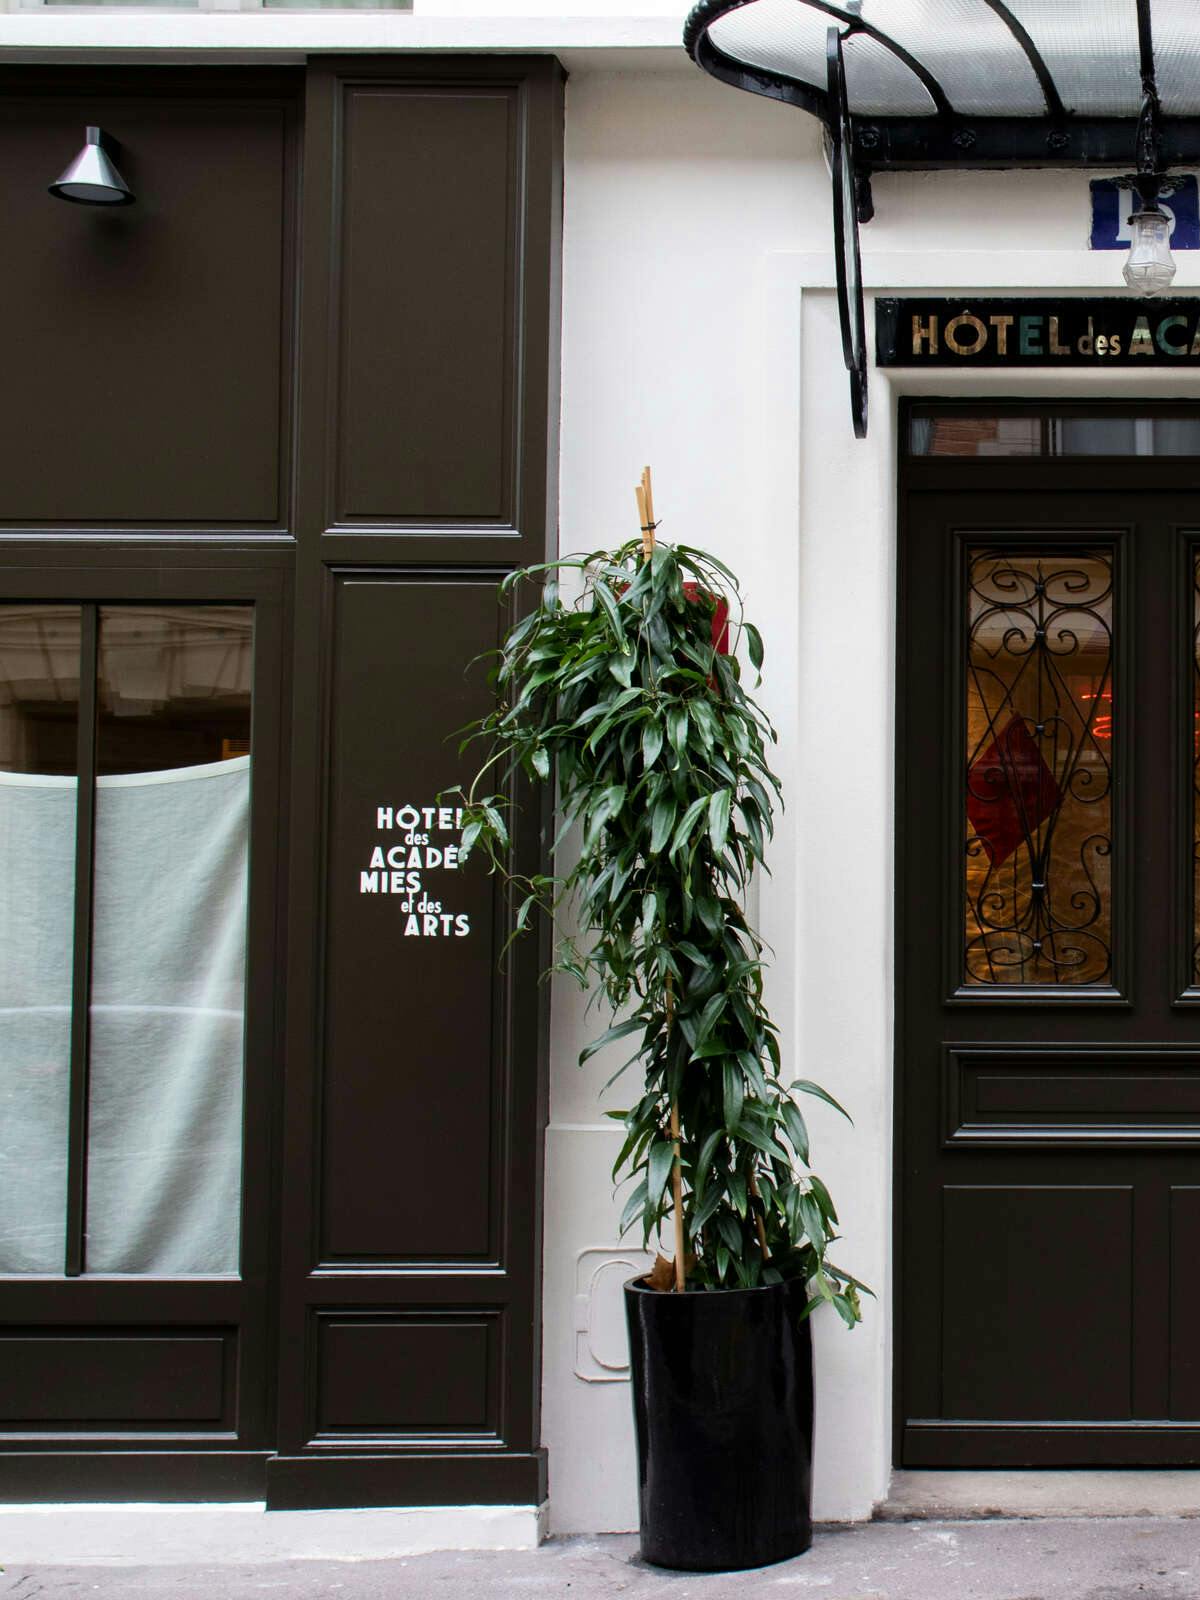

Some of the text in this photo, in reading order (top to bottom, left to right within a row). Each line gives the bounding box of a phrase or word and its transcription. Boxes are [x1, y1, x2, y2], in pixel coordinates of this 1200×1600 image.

[911, 308, 1071, 356] HÔTEL
[1077, 315, 1121, 356] des
[376, 804, 465, 830] HÔTEL
[404, 827, 429, 846] des
[360, 871, 422, 894] MIES
[400, 891, 442, 914] et des
[403, 914, 471, 937] ARTS
